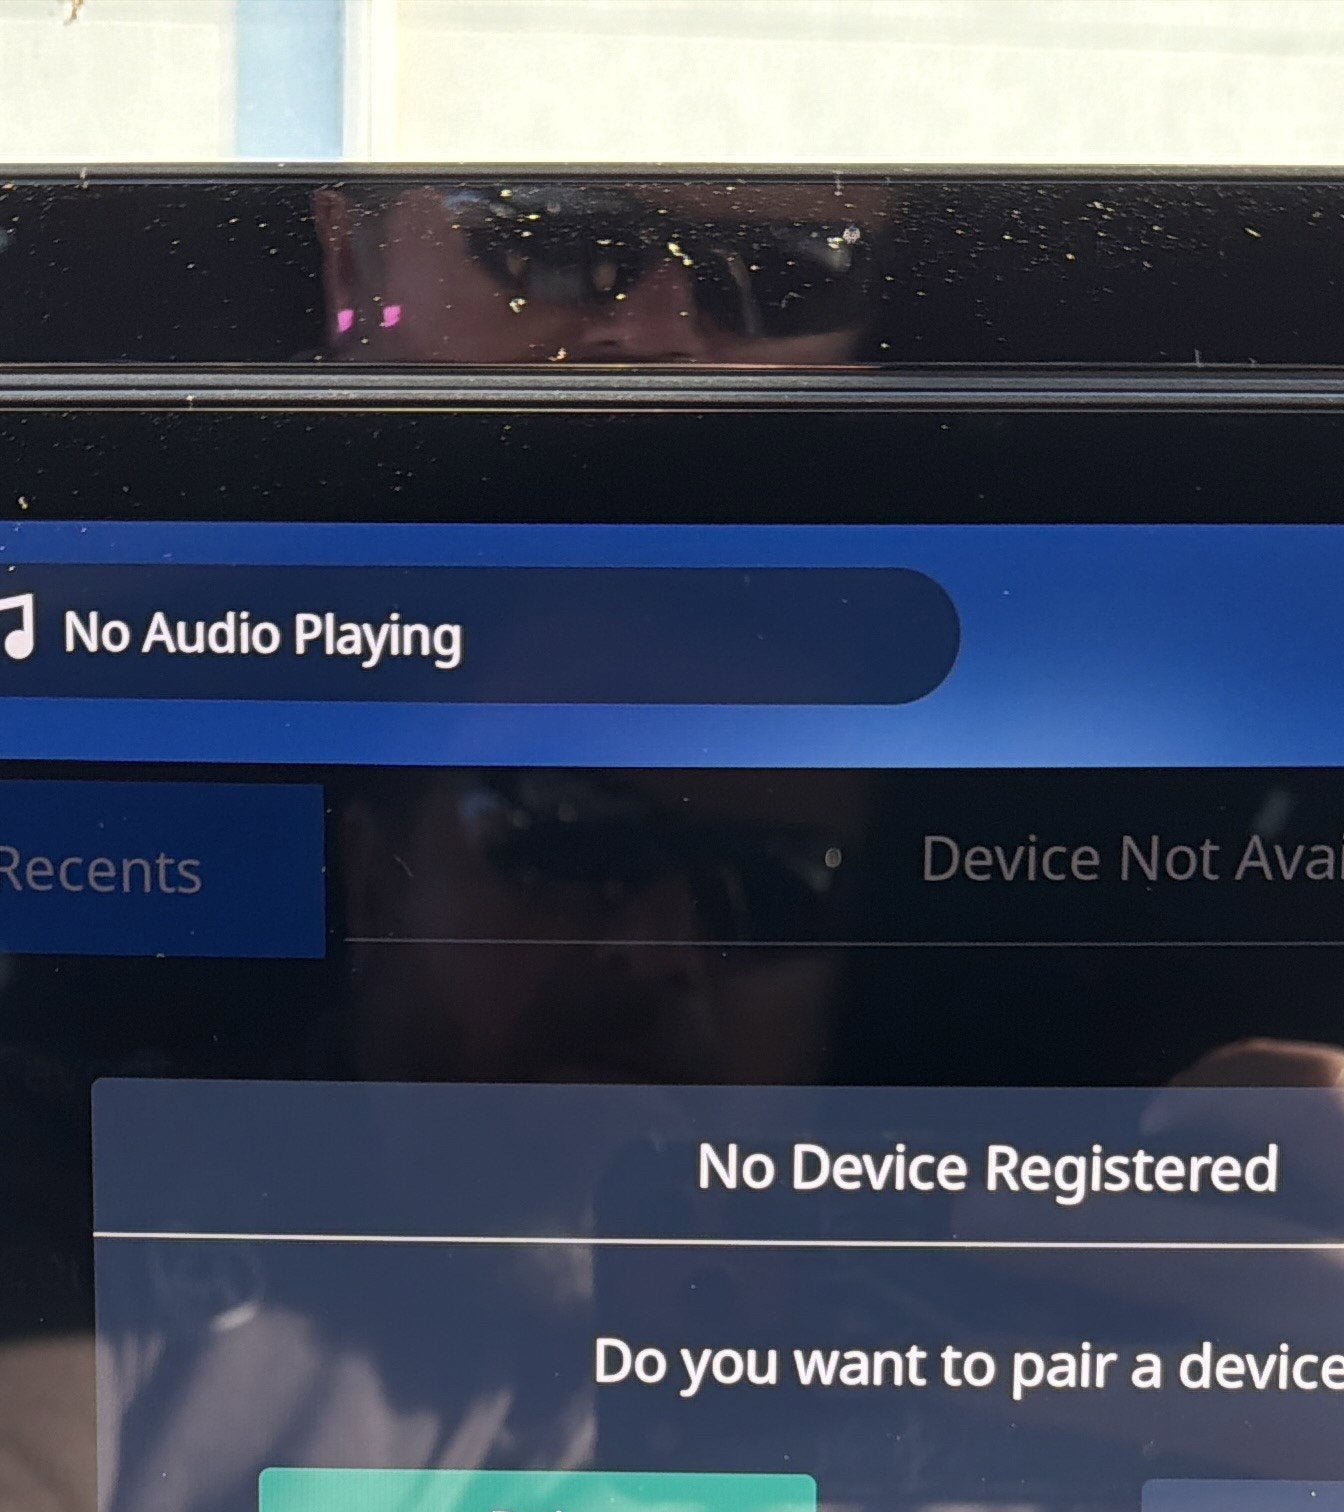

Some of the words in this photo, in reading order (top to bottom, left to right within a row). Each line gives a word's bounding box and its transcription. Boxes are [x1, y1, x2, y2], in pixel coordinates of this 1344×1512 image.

[63, 608, 130, 654] No
[141, 611, 282, 656] Audio
[293, 611, 464, 669] Playing
[921, 833, 1102, 884] Device
[1118, 835, 1221, 884] Not
[697, 1143, 774, 1192] No
[791, 1142, 968, 1192] Device
[985, 1144, 1279, 1205] Registered
[594, 1339, 665, 1384] Do
[680, 1350, 779, 1397] you
[792, 1341, 928, 1388] want
[940, 1345, 997, 1390] to
[1011, 1342, 1119, 1399] pair
[1131, 1354, 1163, 1390] a
